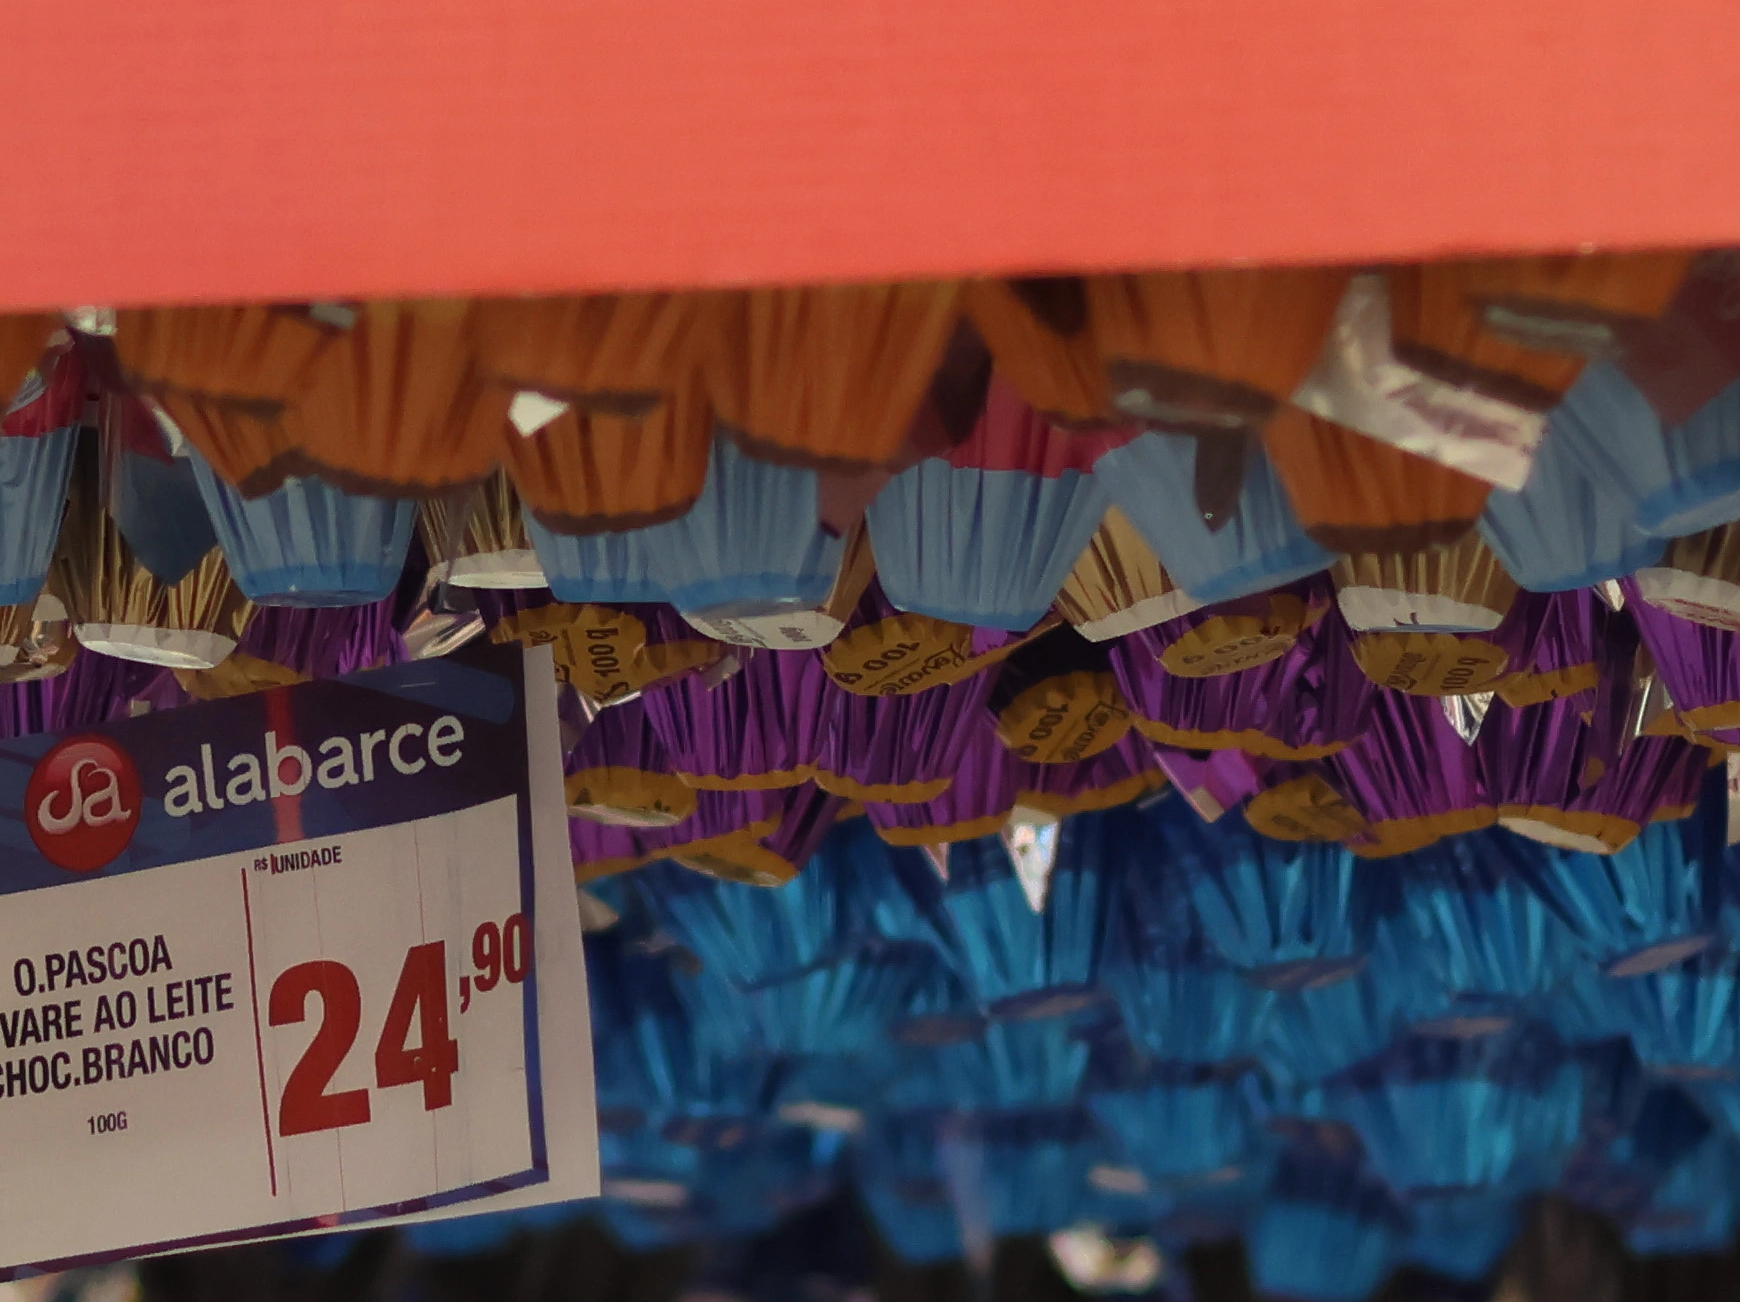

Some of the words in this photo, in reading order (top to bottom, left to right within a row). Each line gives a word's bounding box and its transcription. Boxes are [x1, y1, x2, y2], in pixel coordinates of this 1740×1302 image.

[163, 715, 465, 817] alabarce
[14, 935, 172, 997] O.PASCOA
[93, 991, 137, 1035] AO
[147, 972, 234, 1024] LEITE
[87, 1112, 127, 1135] 100G
